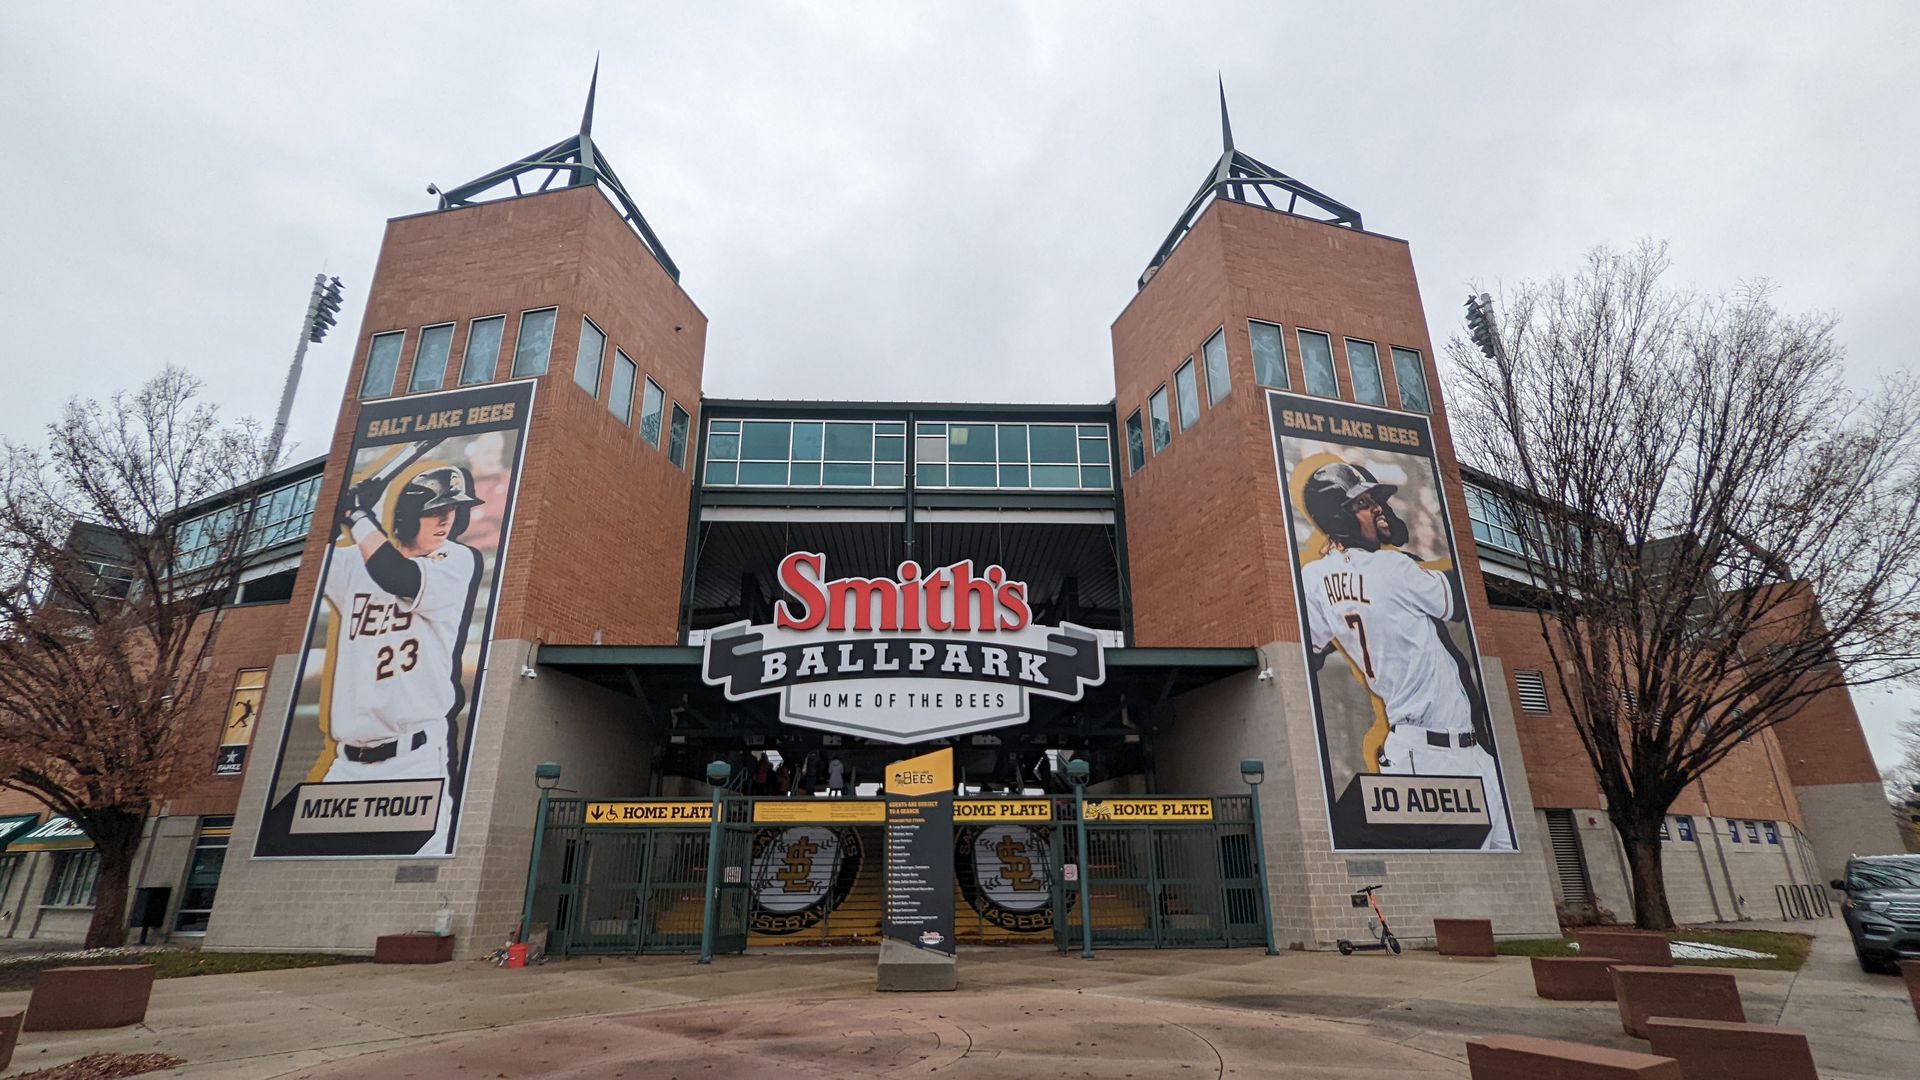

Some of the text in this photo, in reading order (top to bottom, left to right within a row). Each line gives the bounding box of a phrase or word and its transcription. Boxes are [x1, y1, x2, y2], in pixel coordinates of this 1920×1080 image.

[367, 402, 516, 438] SALT LAKE BEES
[1282, 410, 1420, 447] SALT LAKE BEES
[777, 552, 1030, 632] Smith's
[1323, 572, 1371, 606] ADELL
[376, 637, 419, 681] 23
[1344, 613, 1376, 679] 7
[760, 642, 1049, 685] BALLPARK
[808, 692, 1005, 708] HOME OF THE BEES
[300, 795, 433, 819] MIKE TROUT
[623, 806, 668, 819] HOME
[953, 804, 1048, 817] HOME PLATE
[1113, 803, 1209, 816] HOME PLATE
[1371, 787, 1482, 813] JO ADELL
